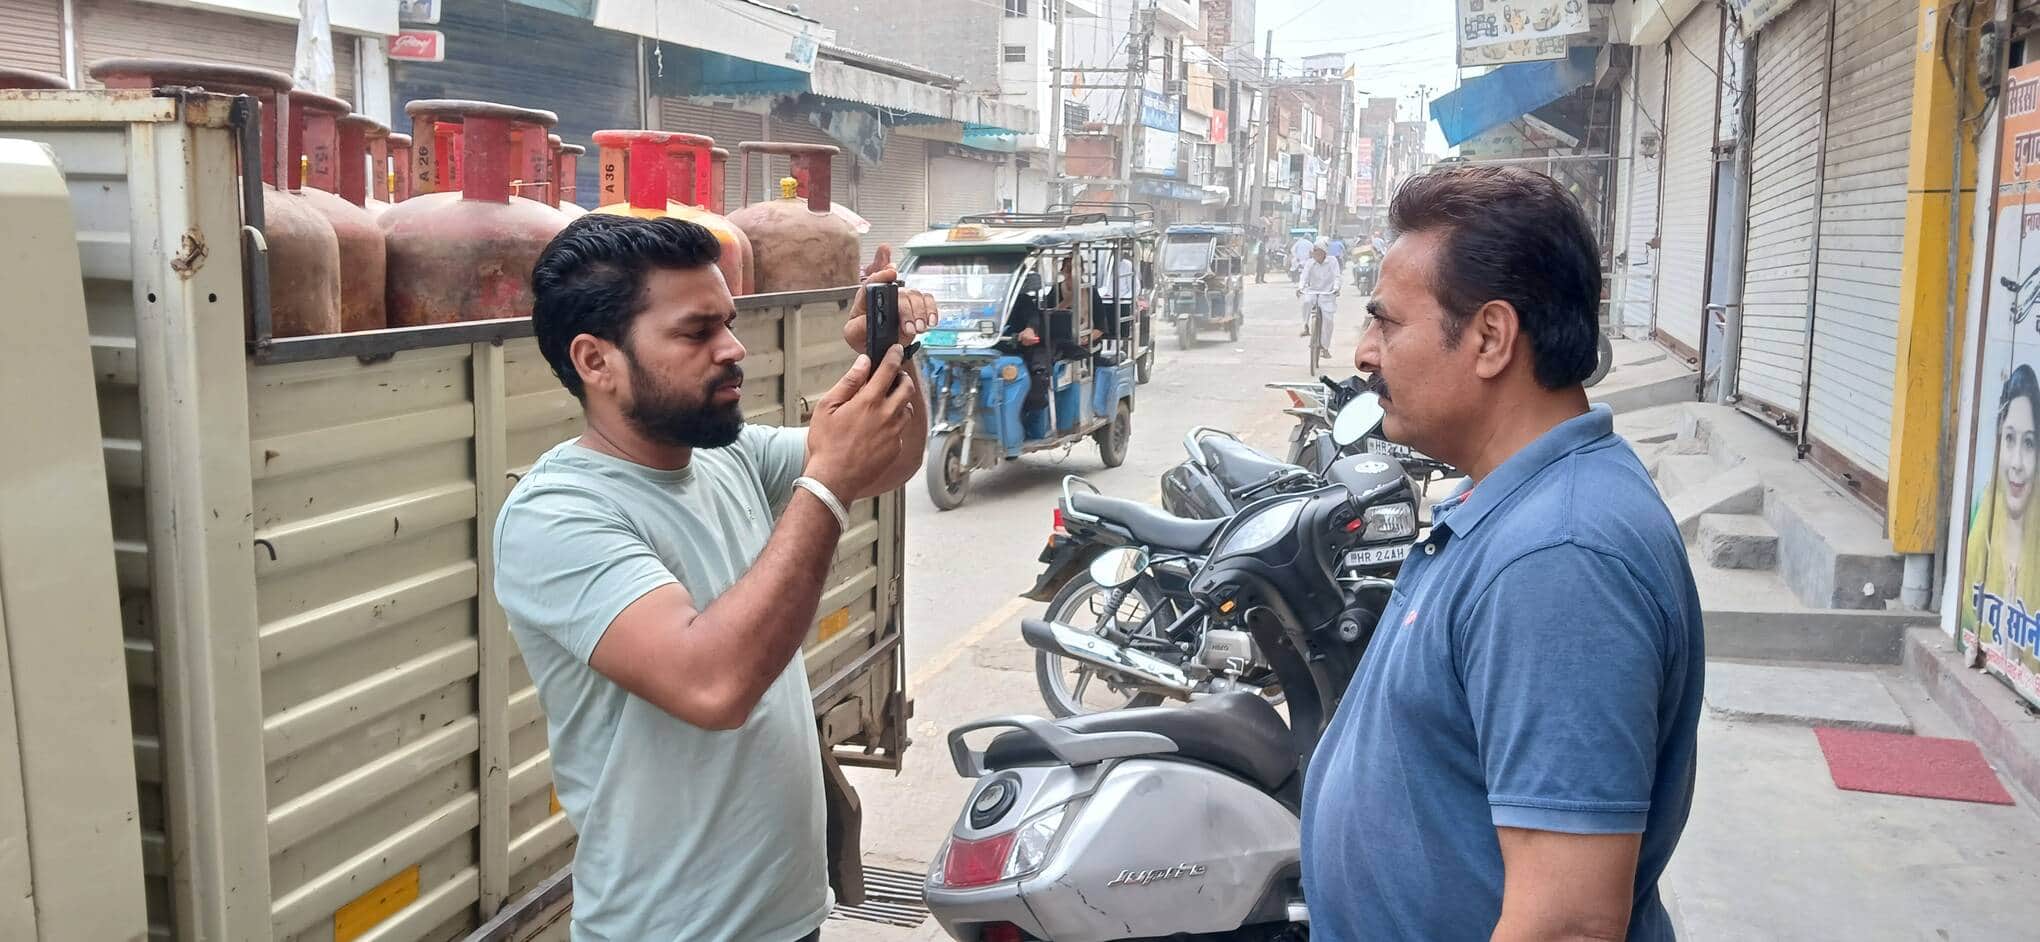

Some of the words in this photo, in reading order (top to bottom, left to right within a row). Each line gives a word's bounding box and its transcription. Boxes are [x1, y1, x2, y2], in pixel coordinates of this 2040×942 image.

[419, 146, 429, 166] 26
[605, 163, 615, 182] 36
[605, 184, 615, 193] A
[1357, 551, 1371, 562] HR
